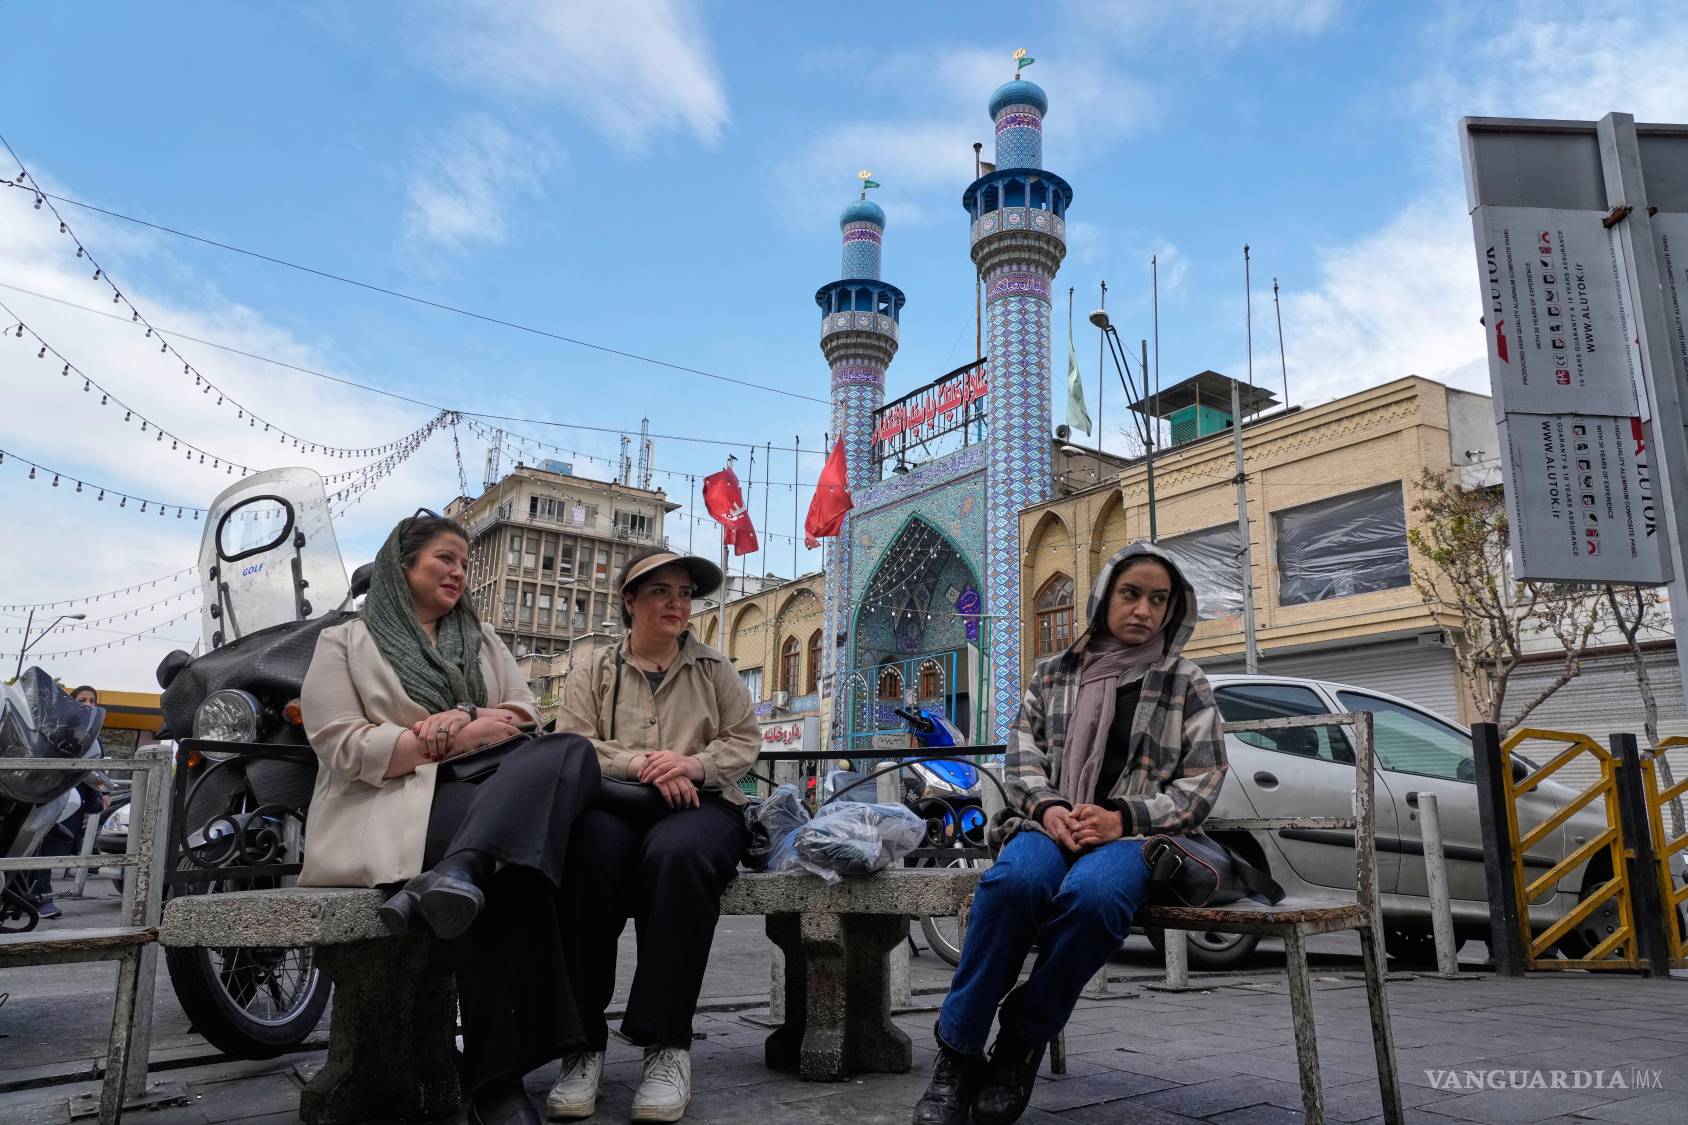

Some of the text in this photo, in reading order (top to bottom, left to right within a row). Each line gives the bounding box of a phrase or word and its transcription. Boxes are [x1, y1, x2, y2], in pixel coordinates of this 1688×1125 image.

[1558, 231, 1568, 270] ASSURANCE
[1526, 263, 1534, 296] EXPERIENCE
[1576, 264, 1595, 352] WWW.ALUTOK.ir
[1542, 421, 1560, 518] WWW.ALUTOK.ir
[1556, 422, 1566, 461] GUARANTY
[1568, 510, 1578, 555] ASSURANCE
[1602, 470, 1608, 479] OF
[1616, 440, 1624, 466] QUALITY
[1624, 501, 1634, 536] COMPOSITE
[1603, 480, 1613, 519] EXPERIENCE
[242, 562, 264, 577] GOLF
[763, 721, 801, 745] داروخانه
